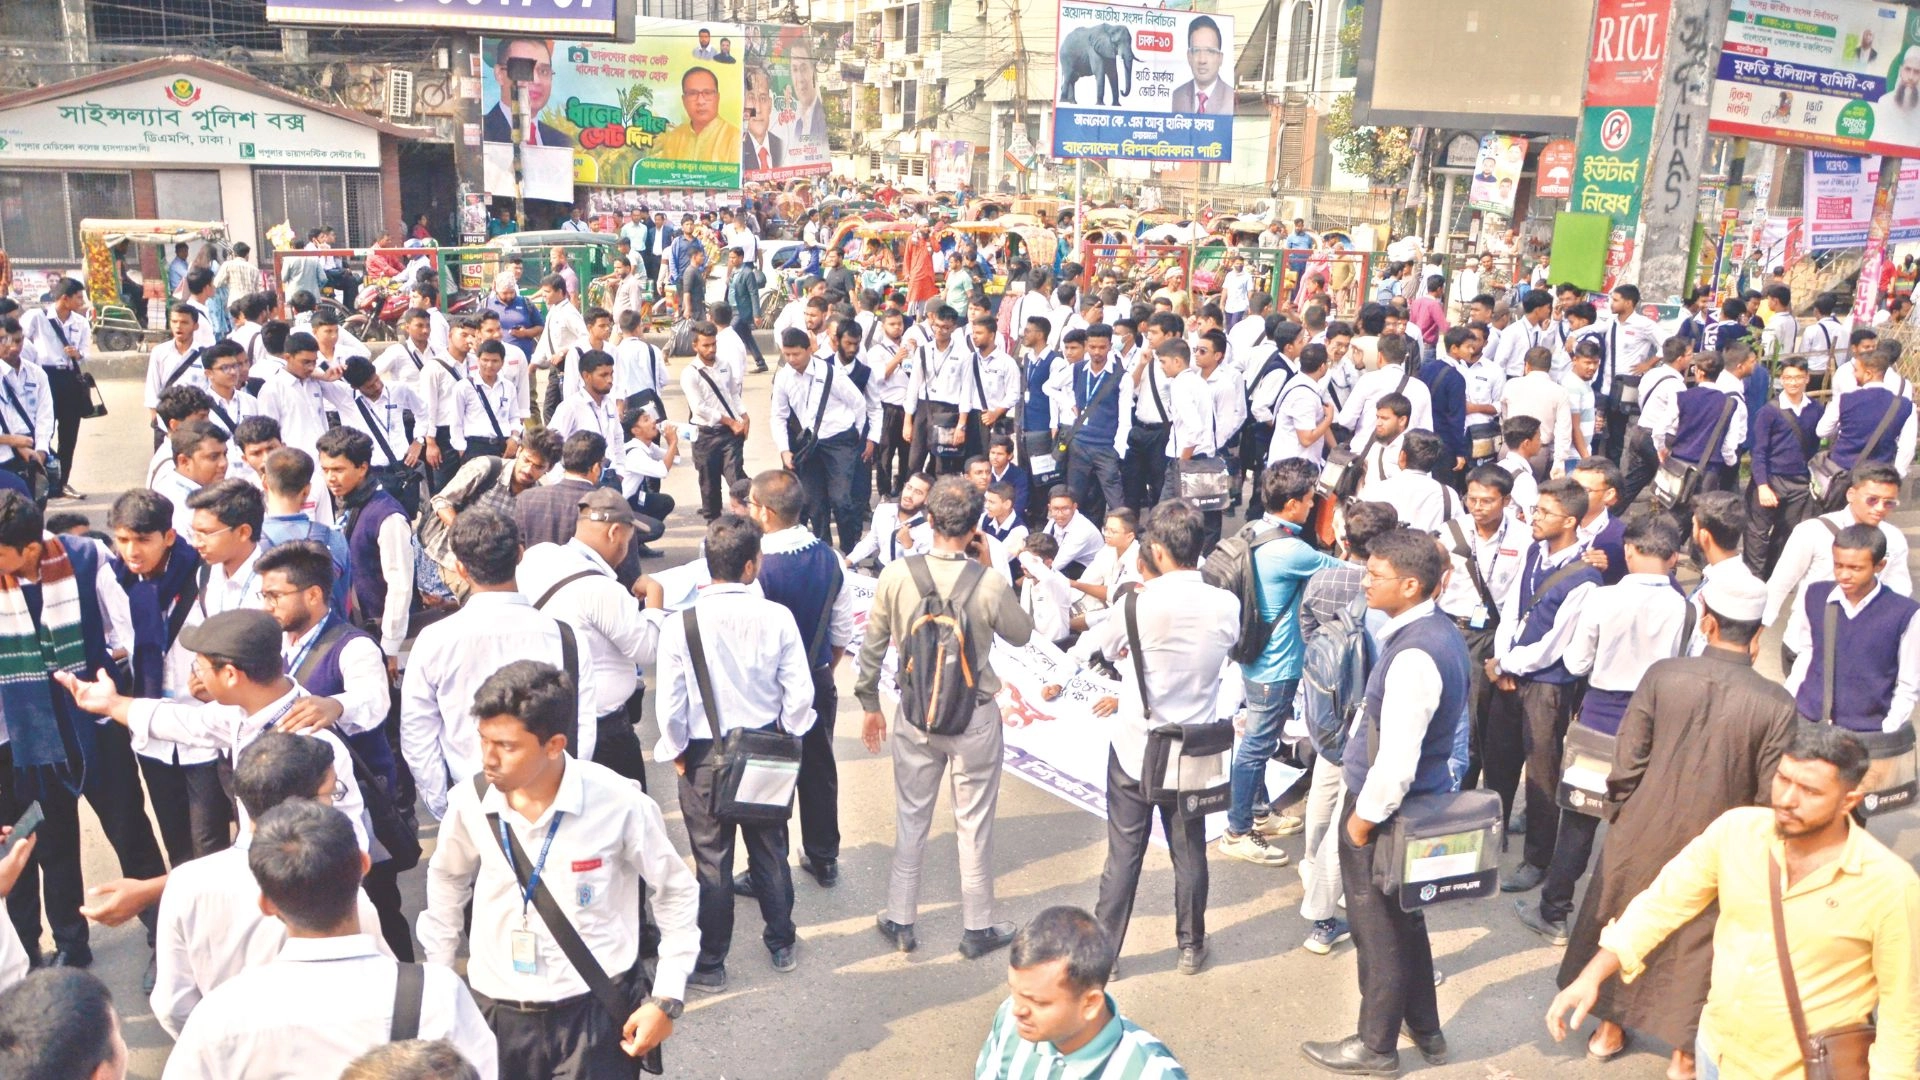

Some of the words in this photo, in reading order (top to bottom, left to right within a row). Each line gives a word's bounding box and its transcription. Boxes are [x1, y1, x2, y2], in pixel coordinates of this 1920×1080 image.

[1062, 6, 1092, 20] ত্রয়োদশ
[1095, 7, 1120, 22] জাতীয়
[1122, 12, 1143, 25] সংসদ
[1145, 11, 1176, 28] নির্বাচনে
[1138, 35, 1170, 48] ঢাকা-১০
[1594, 13, 1661, 63] RICL
[1136, 67, 1150, 83] হাতি
[1152, 71, 1174, 83] মার্কায়
[1734, 58, 1771, 76] মুফতি
[1773, 62, 1817, 84] ইলিয়াস
[1138, 86, 1155, 97] ভোট
[1158, 87, 1170, 97] দিন
[57, 101, 182, 127] সাইন্সল্যাব
[191, 105, 258, 133] পুলিশ
[265, 113, 307, 132] বক্স
[565, 96, 623, 128] ধানের
[632, 105, 669, 134] শীষে
[1074, 113, 1110, 127] জননেতা
[1145, 118, 1164, 133] আবু
[1166, 114, 1192, 131] হানিফ
[144, 131, 194, 146] ডিএমপি,
[579, 123, 626, 149] ভোট
[626, 126, 654, 150] দিন
[1063, 141, 1119, 157] বাংলাদেশ
[1122, 139, 1194, 157] রিপাবলিকান
[1197, 142, 1222, 158] পার্টি
[1583, 155, 1640, 183] ইউটার্ন
[1582, 184, 1632, 215] নিষেধ
